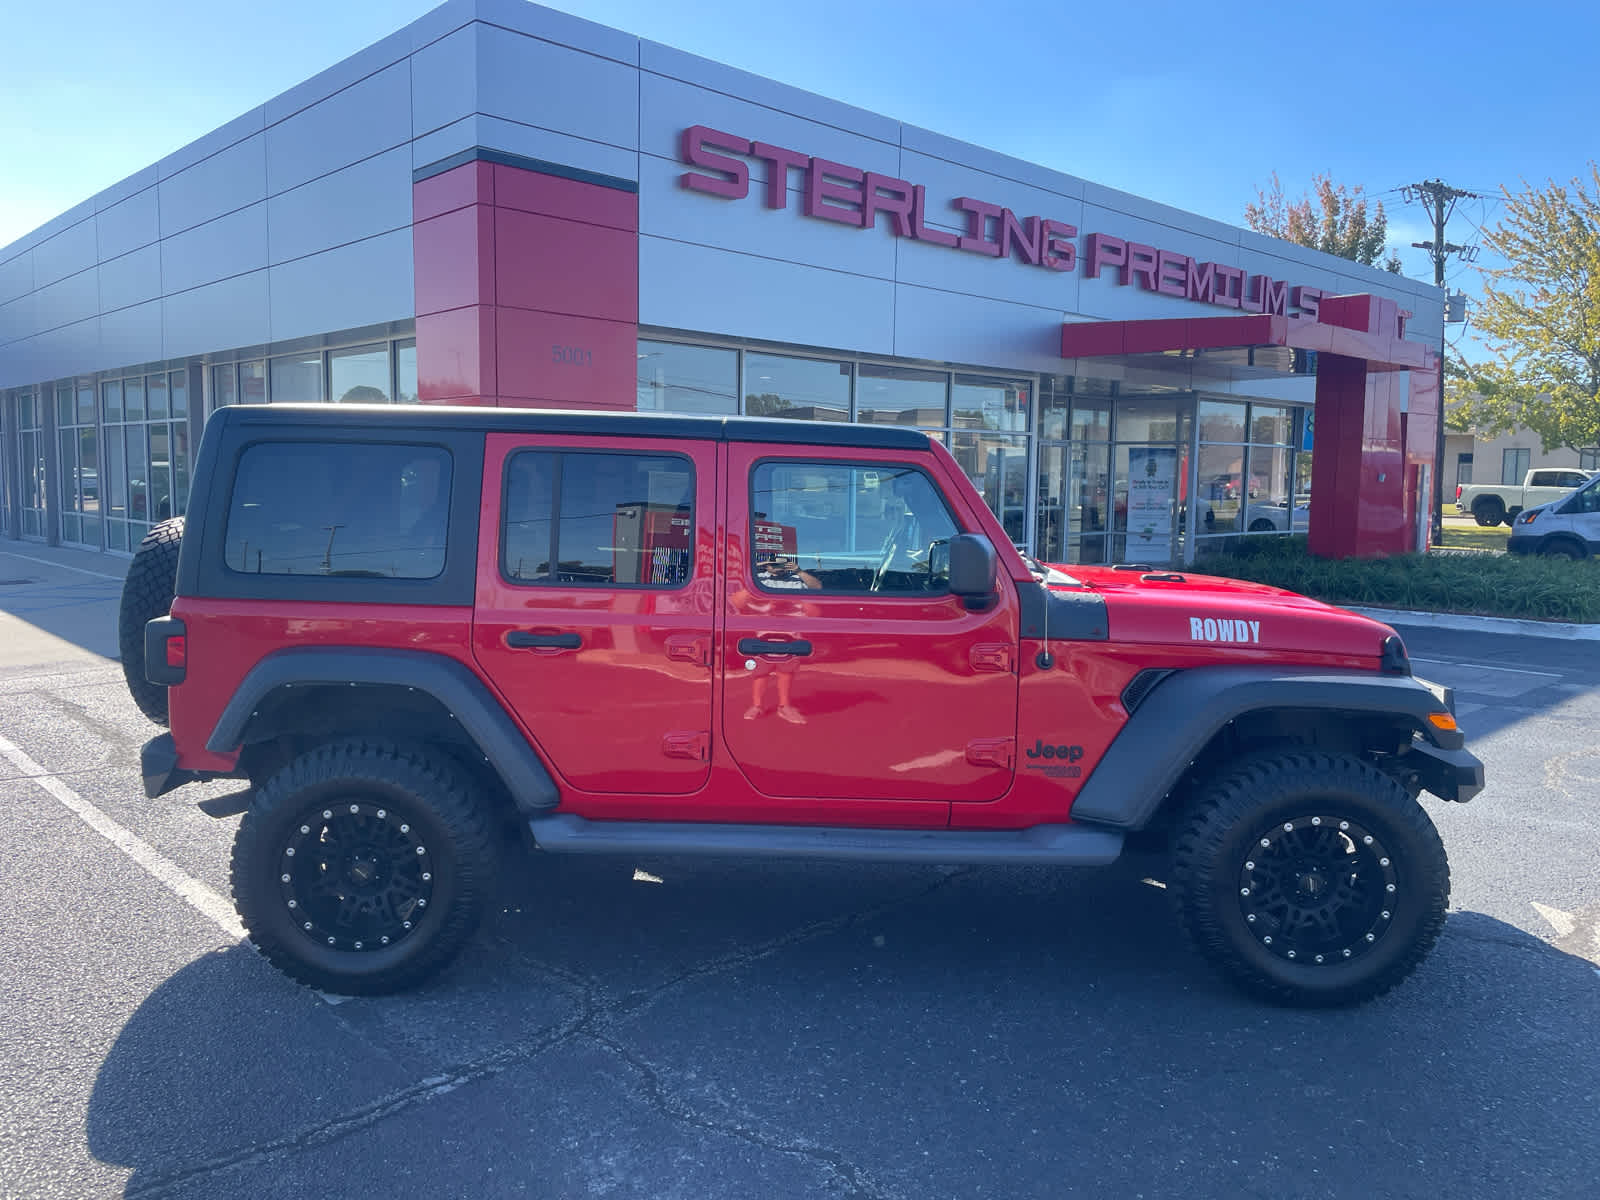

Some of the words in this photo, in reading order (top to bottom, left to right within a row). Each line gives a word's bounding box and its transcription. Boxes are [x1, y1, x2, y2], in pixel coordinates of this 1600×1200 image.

[680, 125, 1077, 272] STERLING
[1087, 232, 1288, 318] PREMIUM
[551, 344, 593, 368] 5001
[1189, 617, 1260, 643] ROWDY
[1026, 739, 1083, 763] Jeep
